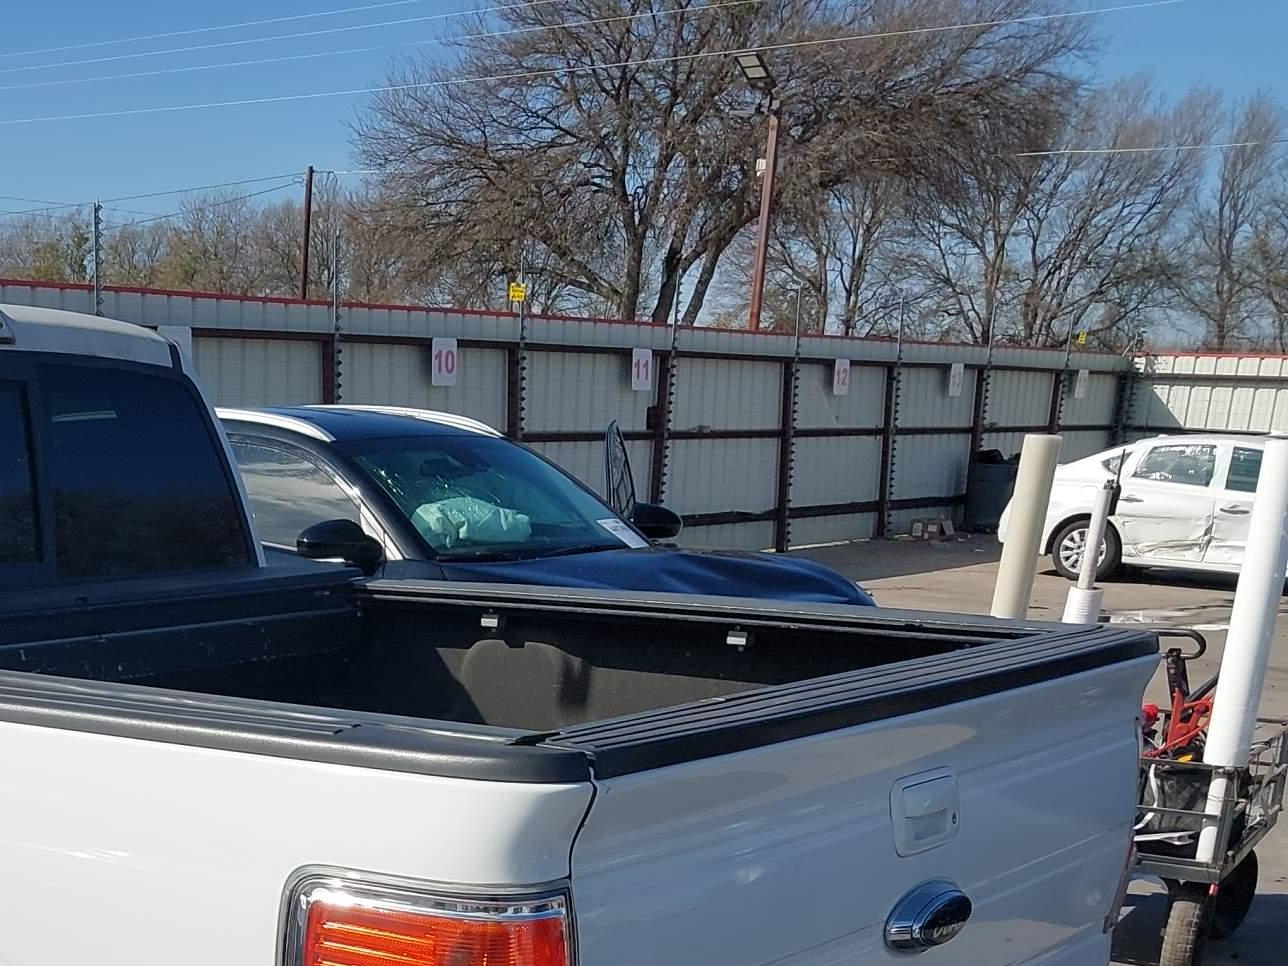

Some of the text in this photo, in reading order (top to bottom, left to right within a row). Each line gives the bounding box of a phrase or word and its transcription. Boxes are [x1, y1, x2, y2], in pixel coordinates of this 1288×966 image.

[434, 350, 455, 374] 10
[634, 358, 649, 380] 11
[836, 367, 848, 386] 12
